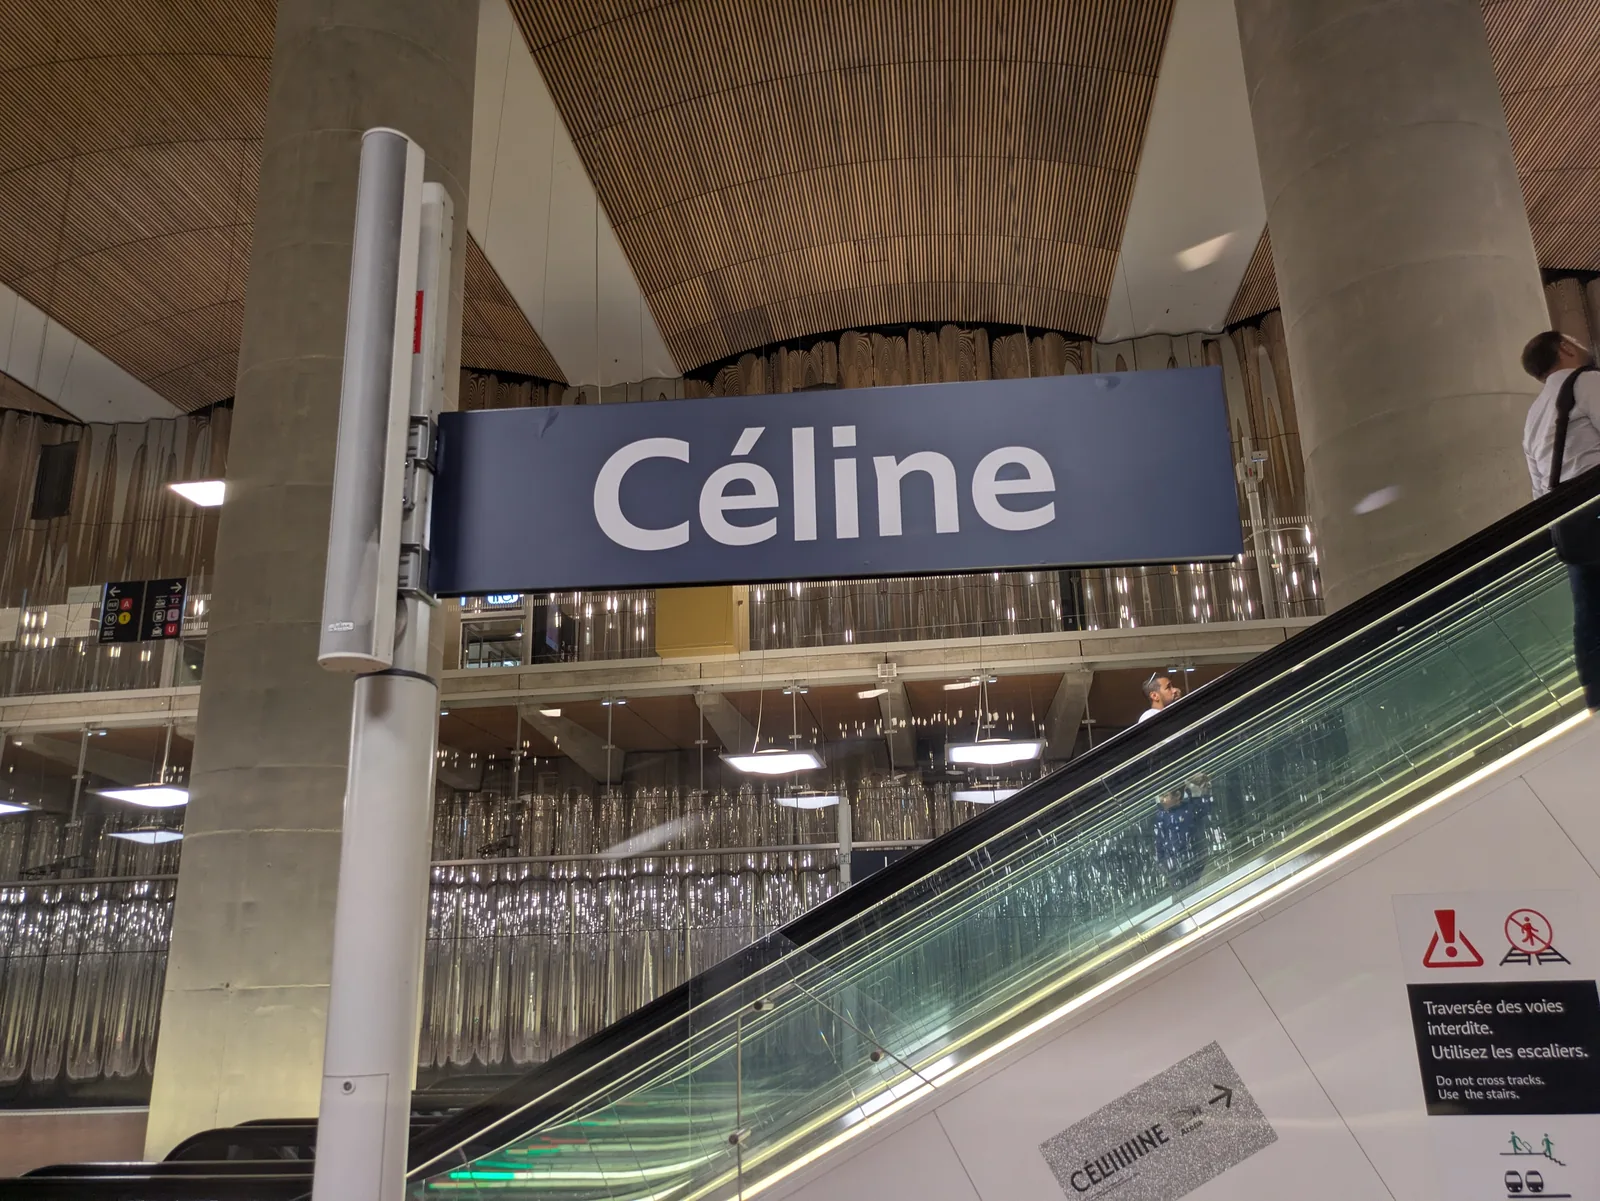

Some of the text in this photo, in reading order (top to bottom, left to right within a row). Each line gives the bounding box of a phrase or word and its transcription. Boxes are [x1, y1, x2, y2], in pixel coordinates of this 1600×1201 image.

[593, 425, 1056, 551] Céline
[1423, 998, 1564, 1015] Traversée des voies
[1427, 1020, 1494, 1036] interdite.
[1431, 1042, 1589, 1060] Utilisez les escaliers.
[1435, 1073, 1546, 1086] Do not cross tracks.
[1438, 1087, 1521, 1100] Use the stairs.
